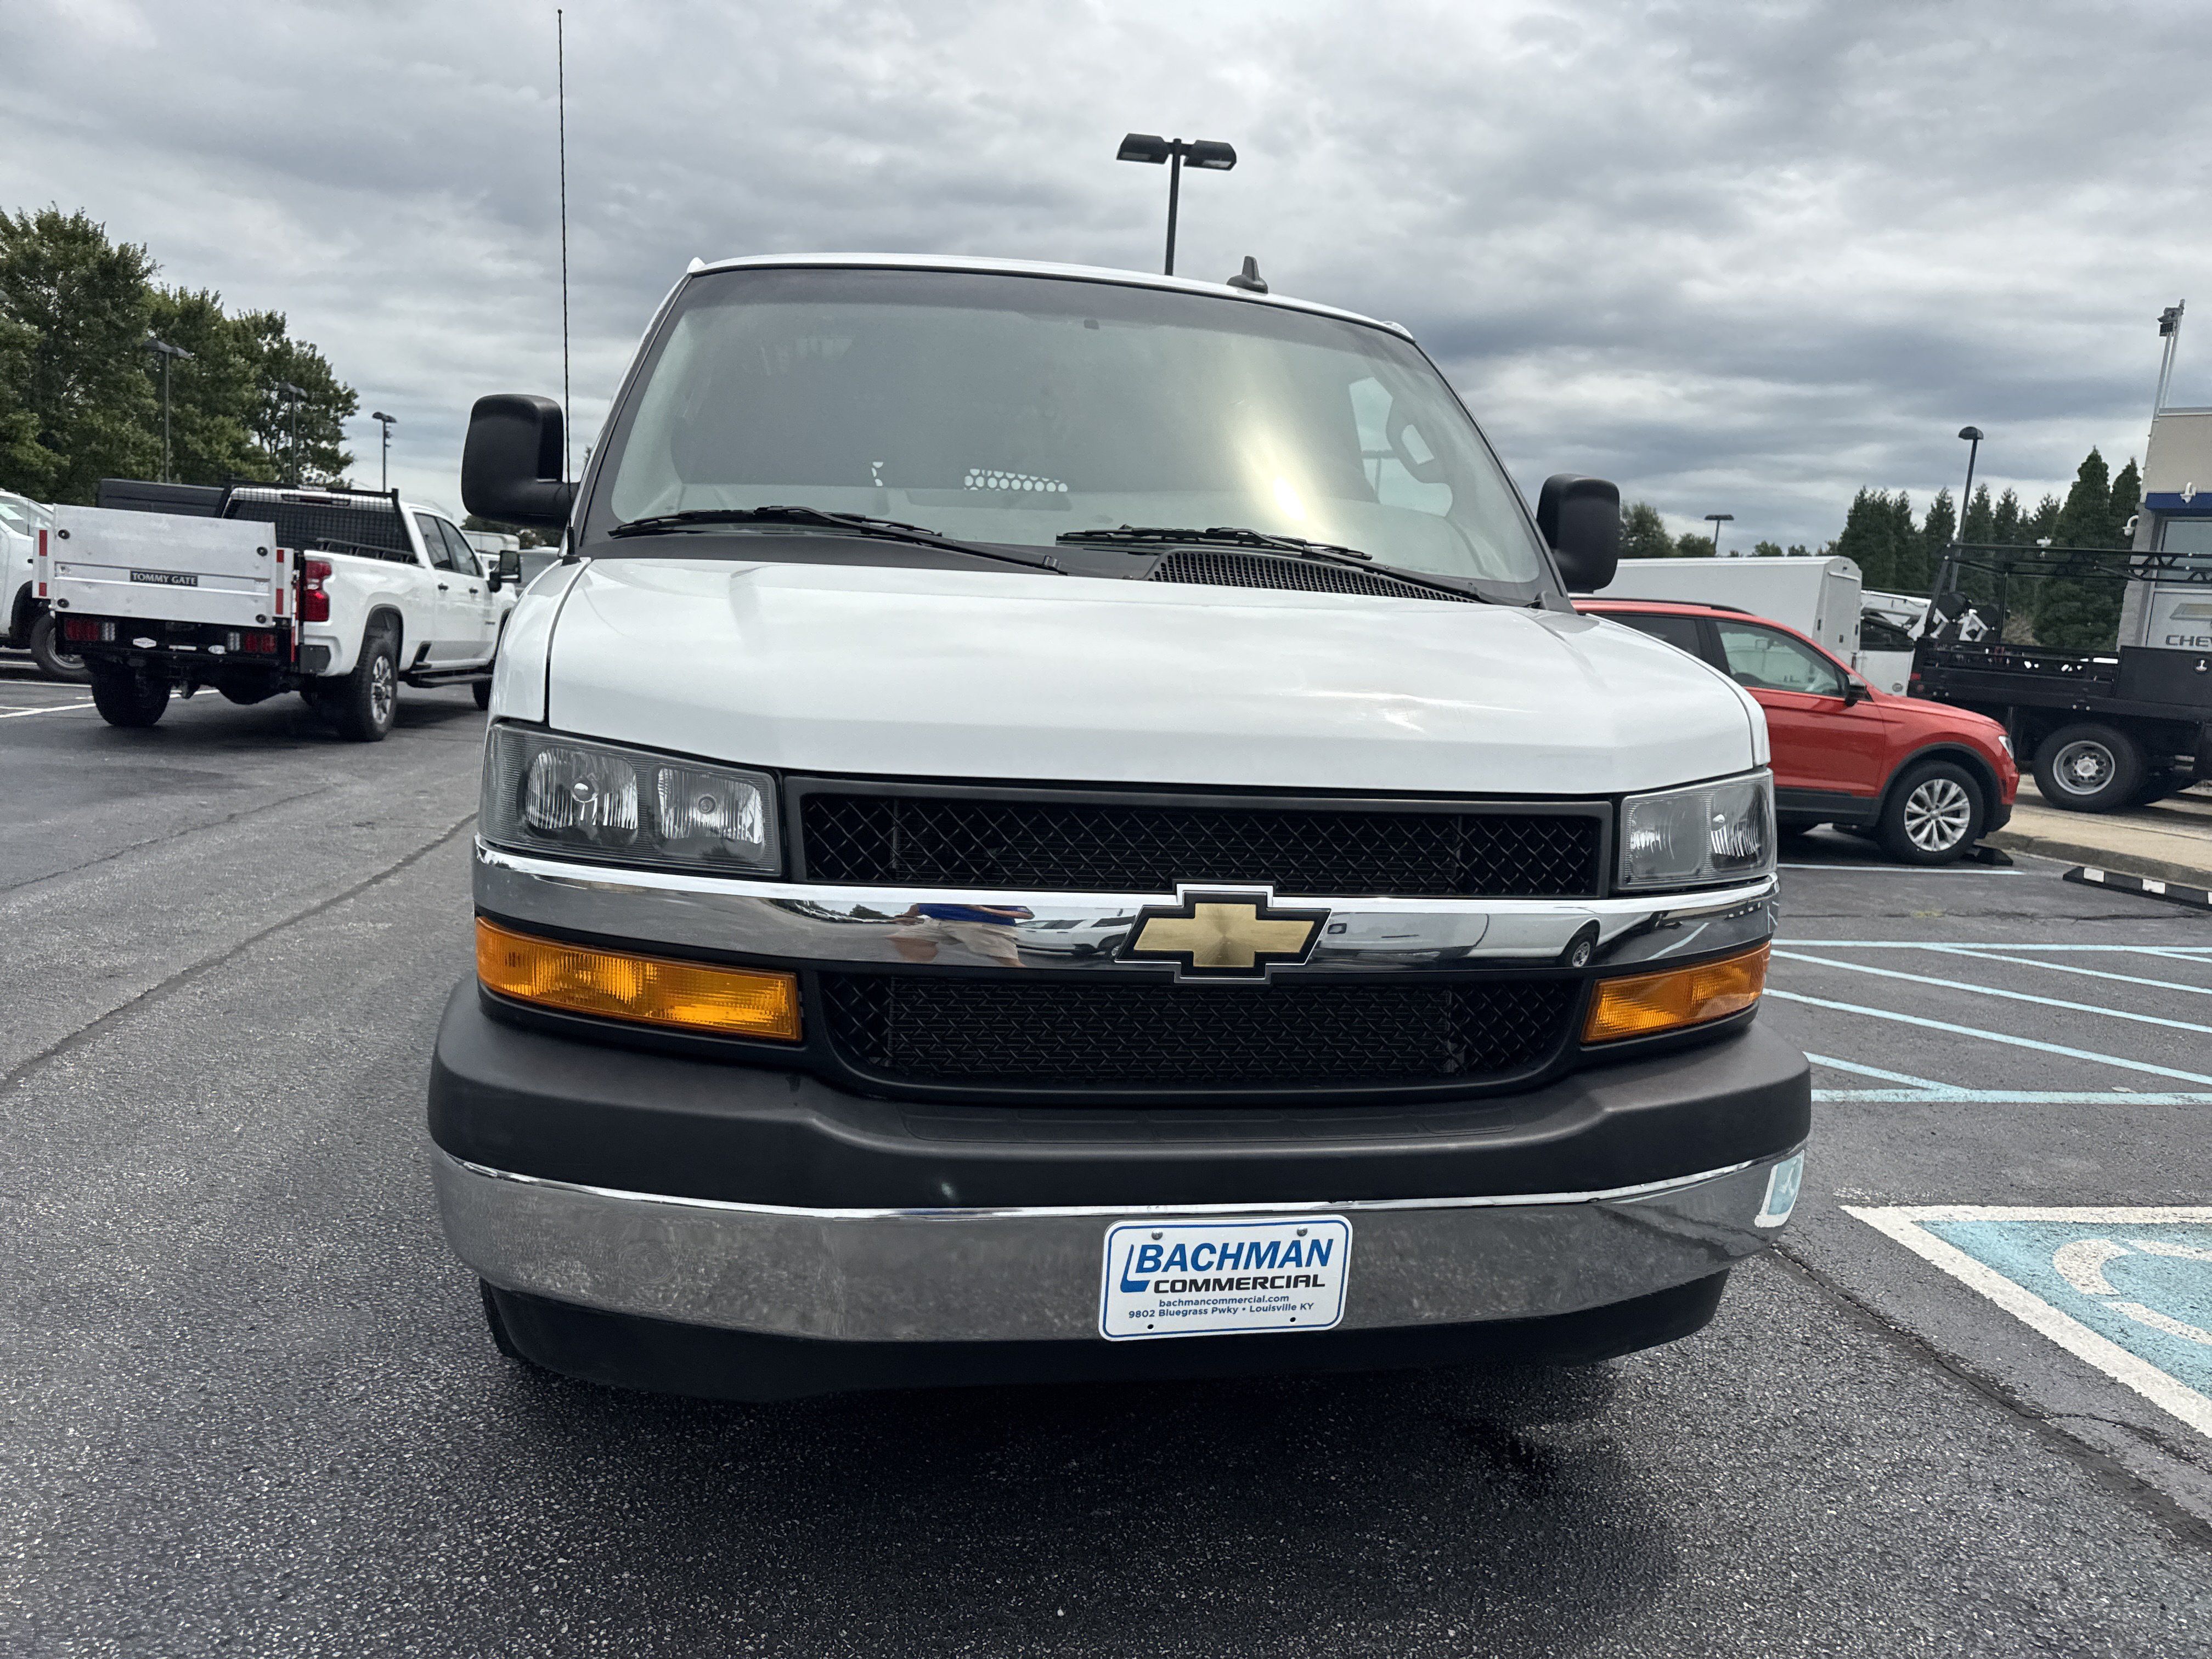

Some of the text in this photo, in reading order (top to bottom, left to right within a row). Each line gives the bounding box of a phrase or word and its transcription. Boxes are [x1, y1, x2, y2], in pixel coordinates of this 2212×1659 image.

[132, 572, 196, 585] TOMMY GATE
[2165, 634, 2212, 647] CHE
[1135, 1238, 1334, 1273] BACHMAN
[1154, 1274, 1325, 1294] COMMERCIAL
[1159, 1295, 1289, 1307] bachmancommercial.com
[1128, 1302, 1314, 1318] 9802 Bluegrass Pwky Louisville KY
